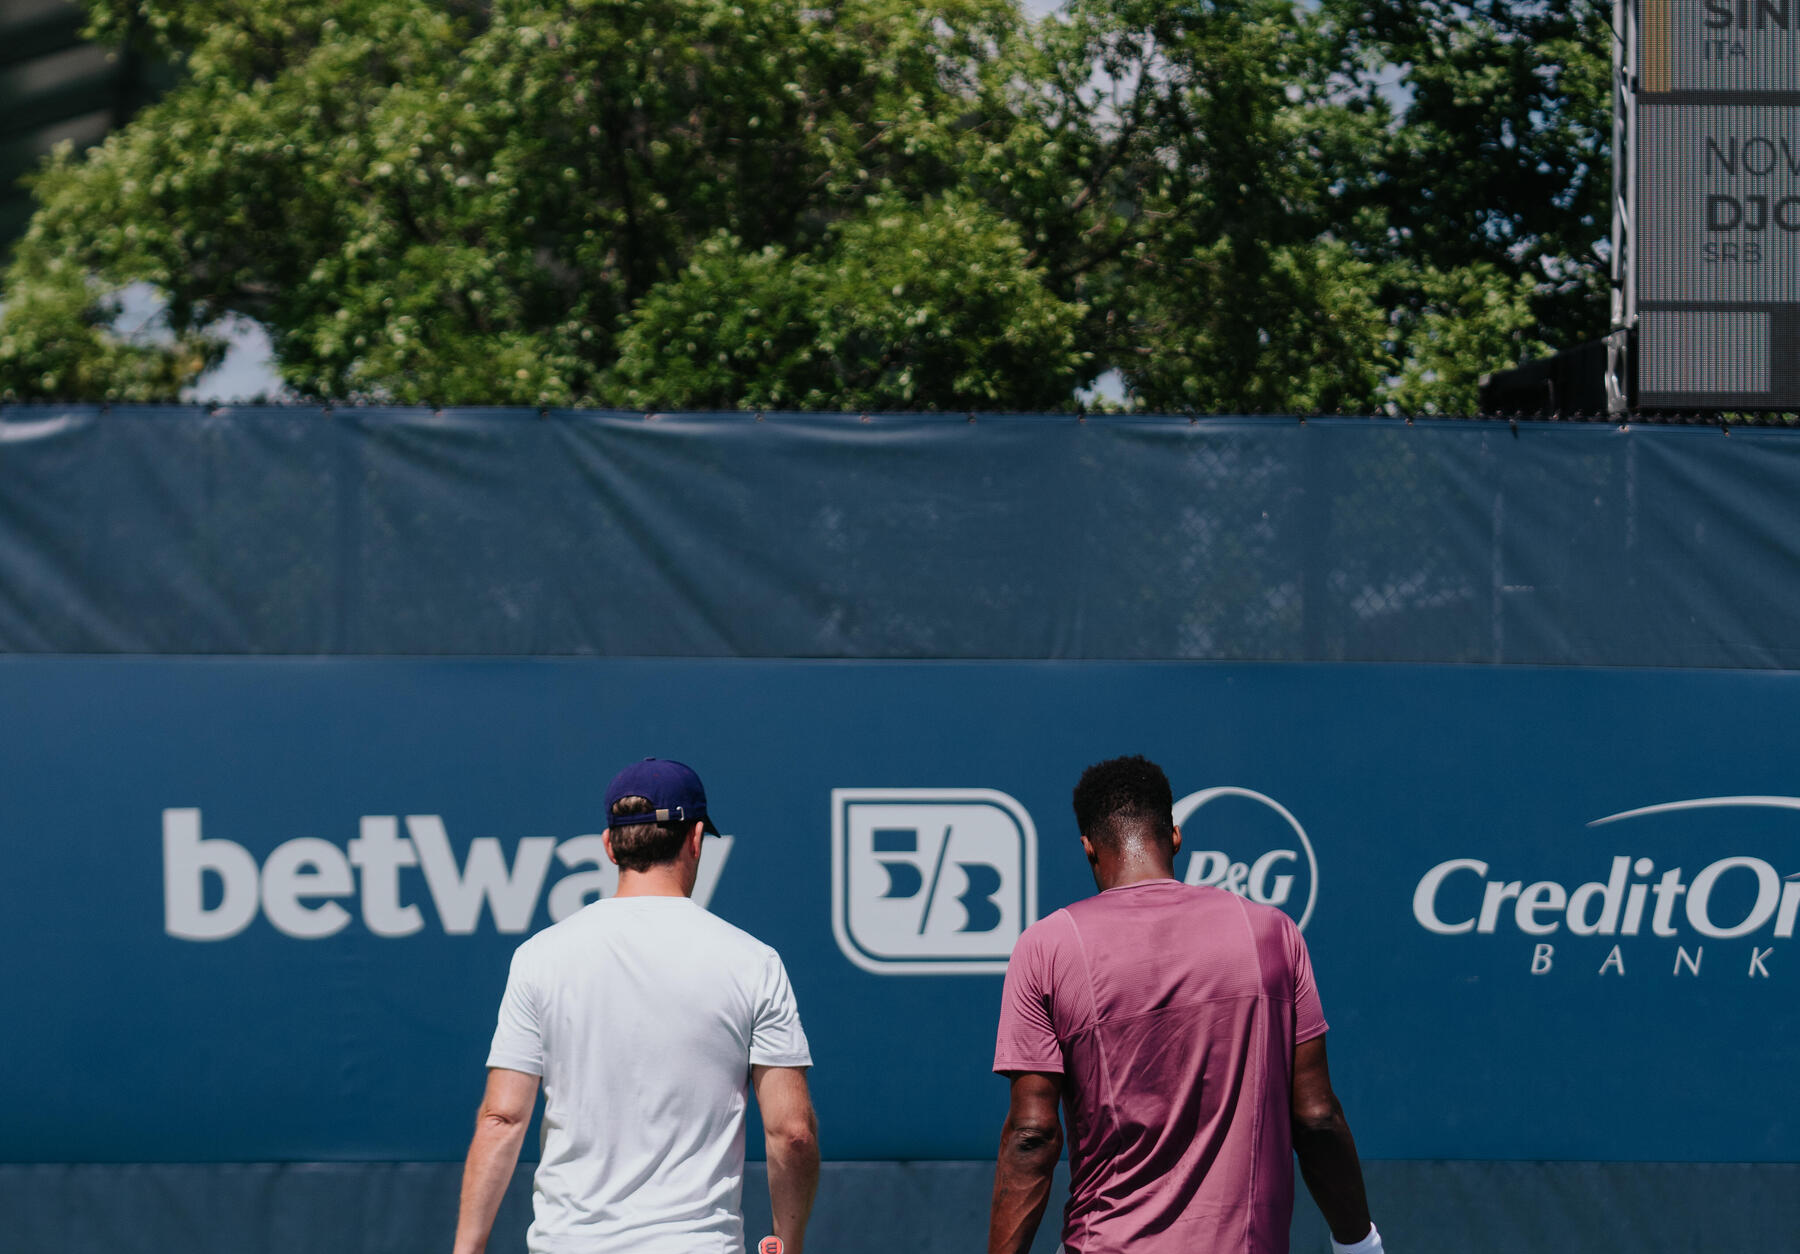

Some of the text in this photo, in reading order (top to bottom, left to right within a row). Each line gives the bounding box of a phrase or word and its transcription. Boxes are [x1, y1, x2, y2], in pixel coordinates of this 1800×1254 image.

[1704, 0, 1800, 29] SIN
[1705, 40, 1746, 60] ITA
[1705, 242, 1760, 263] SRB
[1183, 849, 1298, 907] P&G
[1530, 942, 1774, 978] BANK
